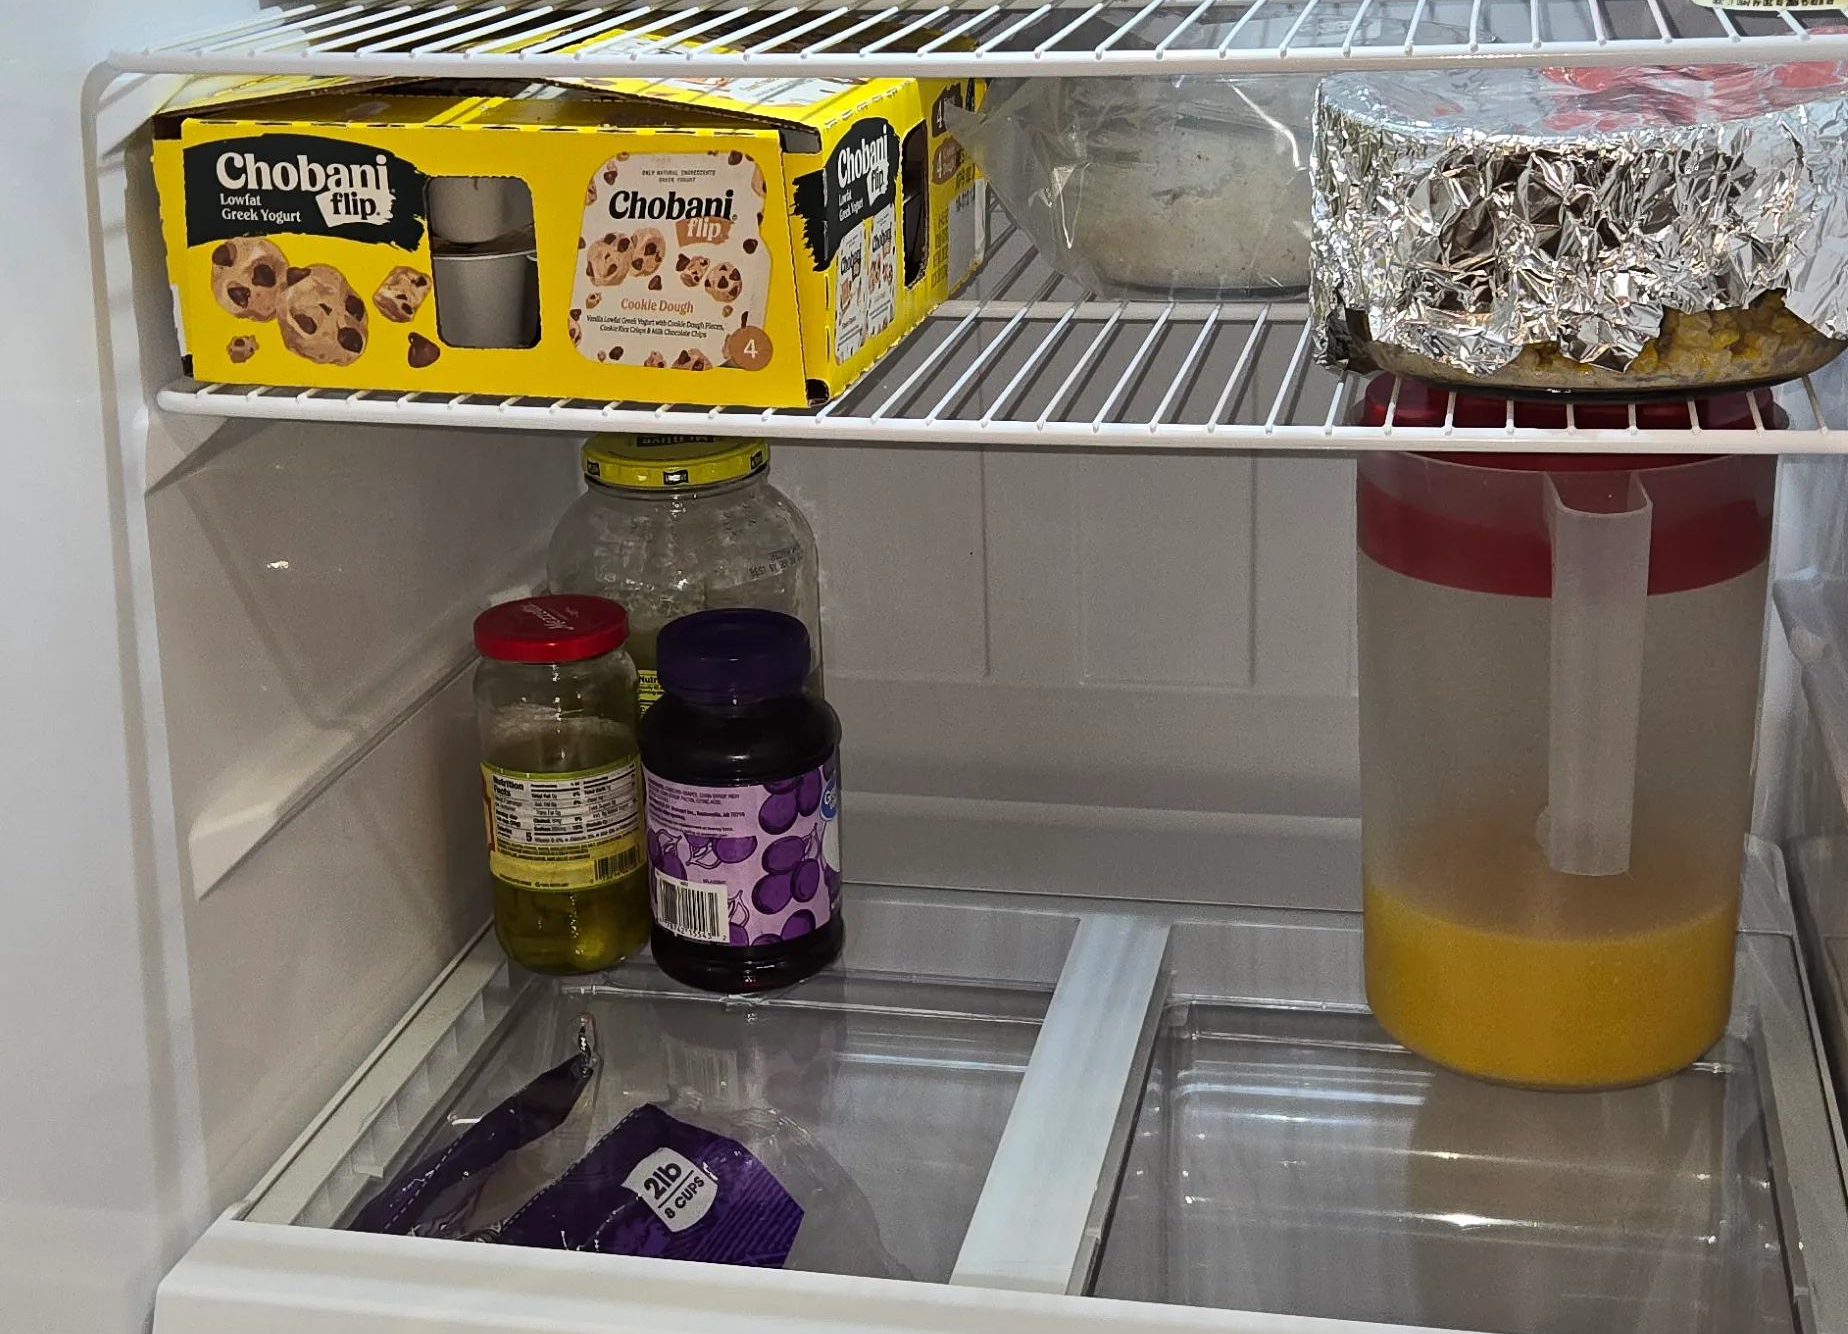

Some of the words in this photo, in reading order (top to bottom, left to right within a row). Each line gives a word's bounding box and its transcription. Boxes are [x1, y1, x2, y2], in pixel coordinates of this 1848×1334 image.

[837, 124, 888, 189] Chobani
[216, 152, 389, 192] Chobani
[871, 167, 884, 194] flip
[220, 193, 262, 206] Lowfat
[330, 192, 377, 220] flip
[609, 189, 734, 221] Chobani
[838, 189, 852, 207] Lowfat
[221, 208, 258, 221] Greek
[261, 209, 302, 224] Yogurt
[839, 205, 851, 222] Greek
[851, 197, 864, 218] Yogurt
[687, 217, 721, 242] flip
[621, 297, 657, 311] Cookie
[659, 299, 694, 315] Dough
[600, 324, 617, 332] Cookie
[630, 326, 646, 335] Crisps
[664, 328, 690, 337] Chocolate
[691, 330, 707, 340] Chips
[604, 315, 620, 323] Lowfat
[638, 318, 654, 326] Yogurt
[668, 320, 686, 328] Cookie
[686, 321, 704, 330] Dough
[744, 339, 758, 359] 4
[493, 775, 524, 790] Nutrition
[494, 786, 511, 797] Facts
[526, 832, 532, 842] 5
[644, 1163, 682, 1200] 2lb
[664, 1207, 675, 1219] 8
[675, 1176, 705, 1209] CUPS
